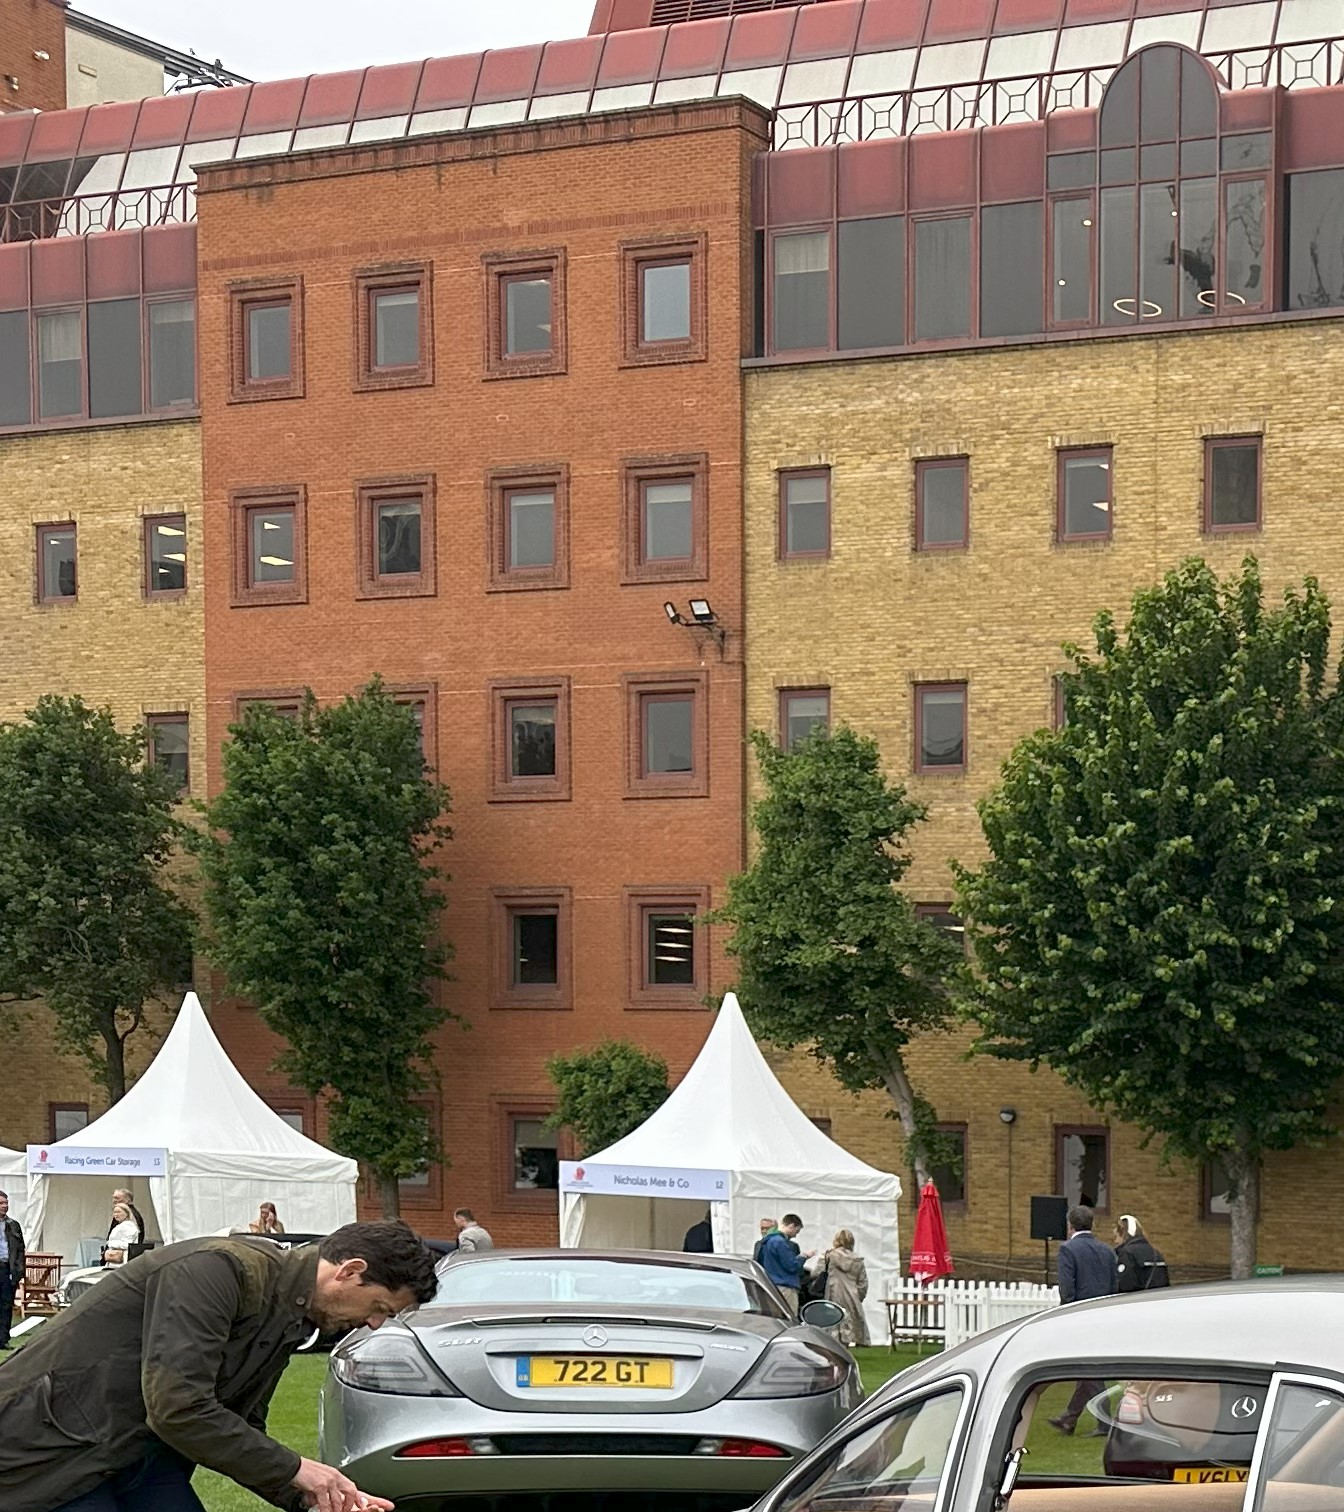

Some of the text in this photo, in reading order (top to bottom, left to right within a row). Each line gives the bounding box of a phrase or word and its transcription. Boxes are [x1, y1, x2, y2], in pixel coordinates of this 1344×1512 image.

[64, 1155, 85, 1167] Racing
[86, 1156, 104, 1166] Green
[105, 1156, 116, 1166] Car
[118, 1157, 140, 1168] Storage
[613, 1175, 690, 1189] Nicholas Mee & Co
[715, 1180, 724, 1190] 12
[553, 1360, 650, 1383] 722 GT
